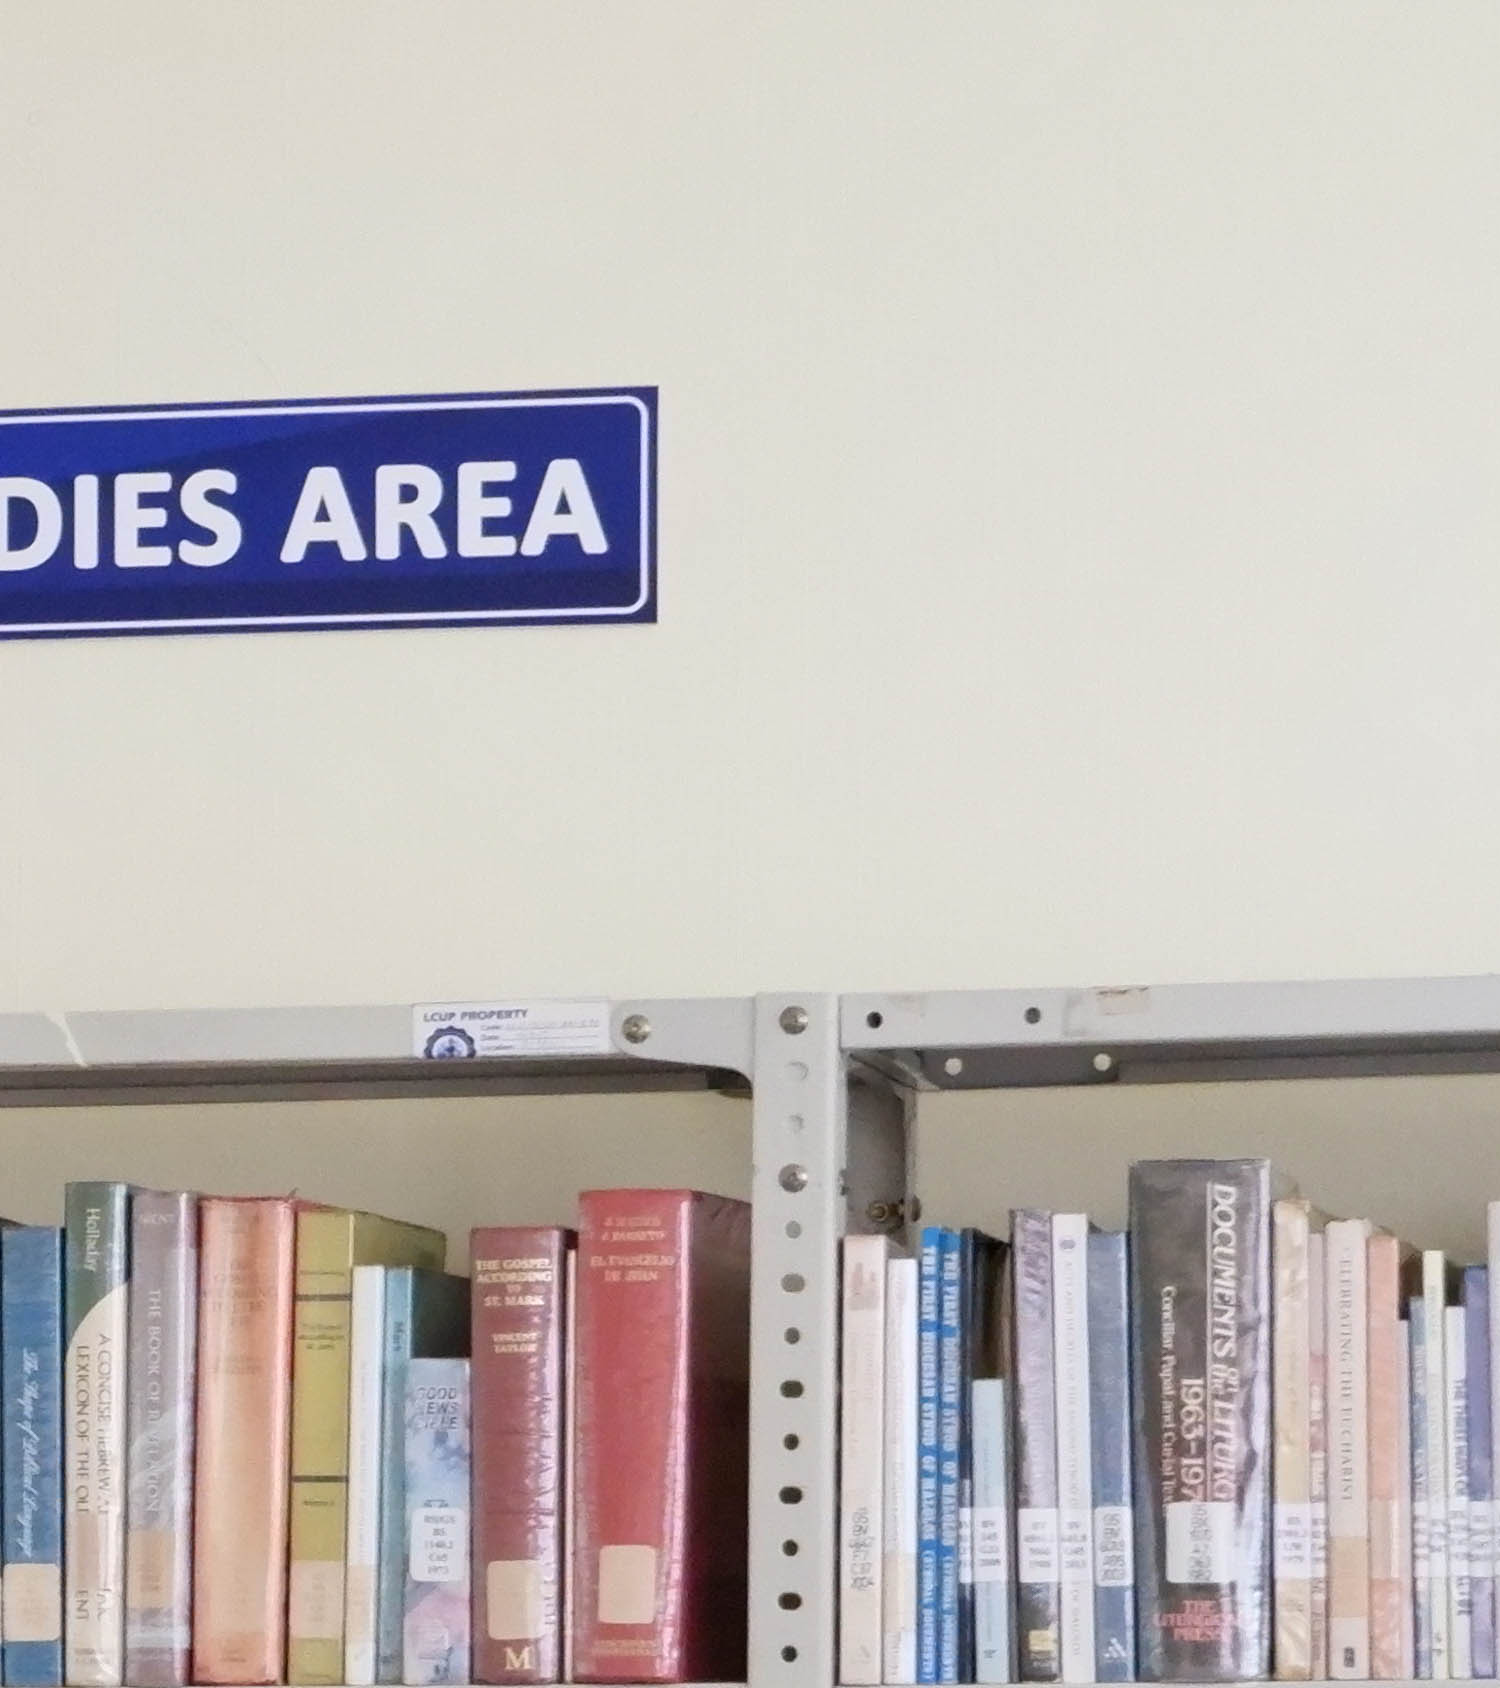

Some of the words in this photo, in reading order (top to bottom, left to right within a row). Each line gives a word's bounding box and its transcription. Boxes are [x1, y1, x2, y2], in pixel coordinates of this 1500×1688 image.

[280, 455, 608, 568] AREA
[423, 1012, 456, 1023] LCUP
[461, 1008, 529, 1021] PROPERTY
[80, 1207, 102, 1273] Holladay
[476, 1271, 553, 1282] ACCORDING
[502, 1258, 553, 1270] GOSPEL
[1211, 1183, 1238, 1357] DOCUMENTS
[74, 1344, 91, 1417] LEXICON
[96, 1349, 114, 1425] CONCISE
[75, 1418, 91, 1446] OF
[502, 1645, 537, 1671] M
